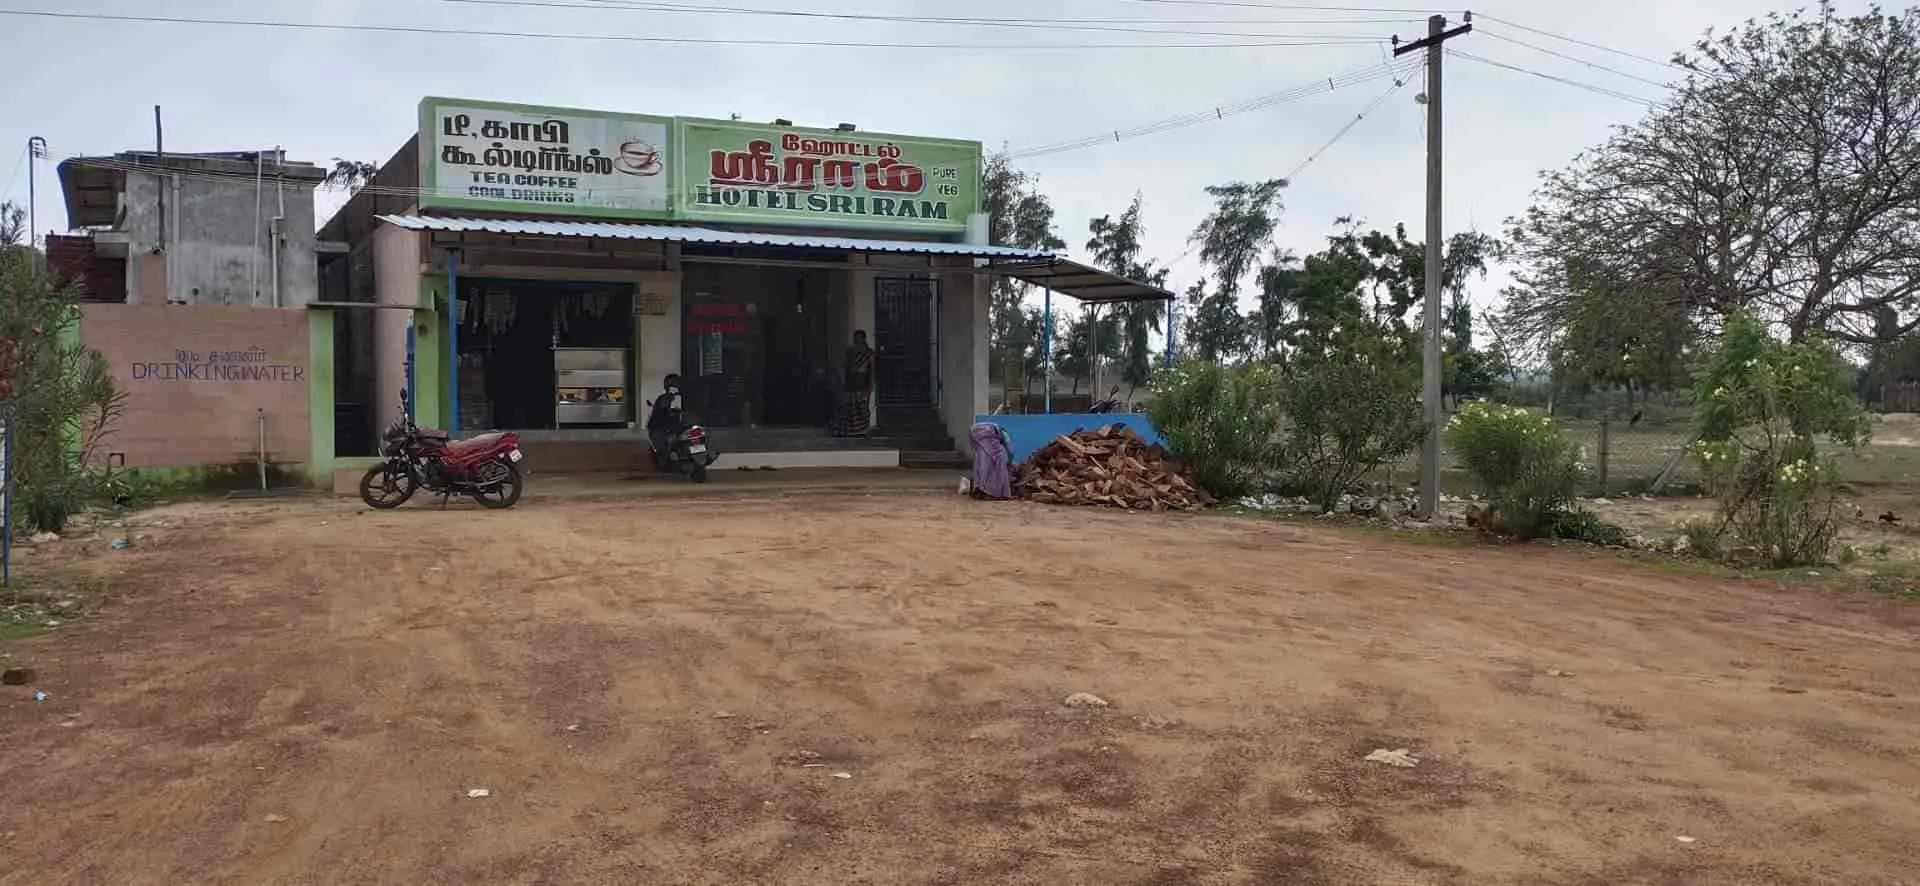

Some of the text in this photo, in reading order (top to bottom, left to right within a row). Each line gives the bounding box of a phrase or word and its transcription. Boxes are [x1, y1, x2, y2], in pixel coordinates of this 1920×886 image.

[933, 167, 957, 179] PURE
[936, 186, 960, 197] VEG
[695, 185, 949, 219] HOTEL SRI RAM
[132, 362, 304, 382] DRINKING WATER
